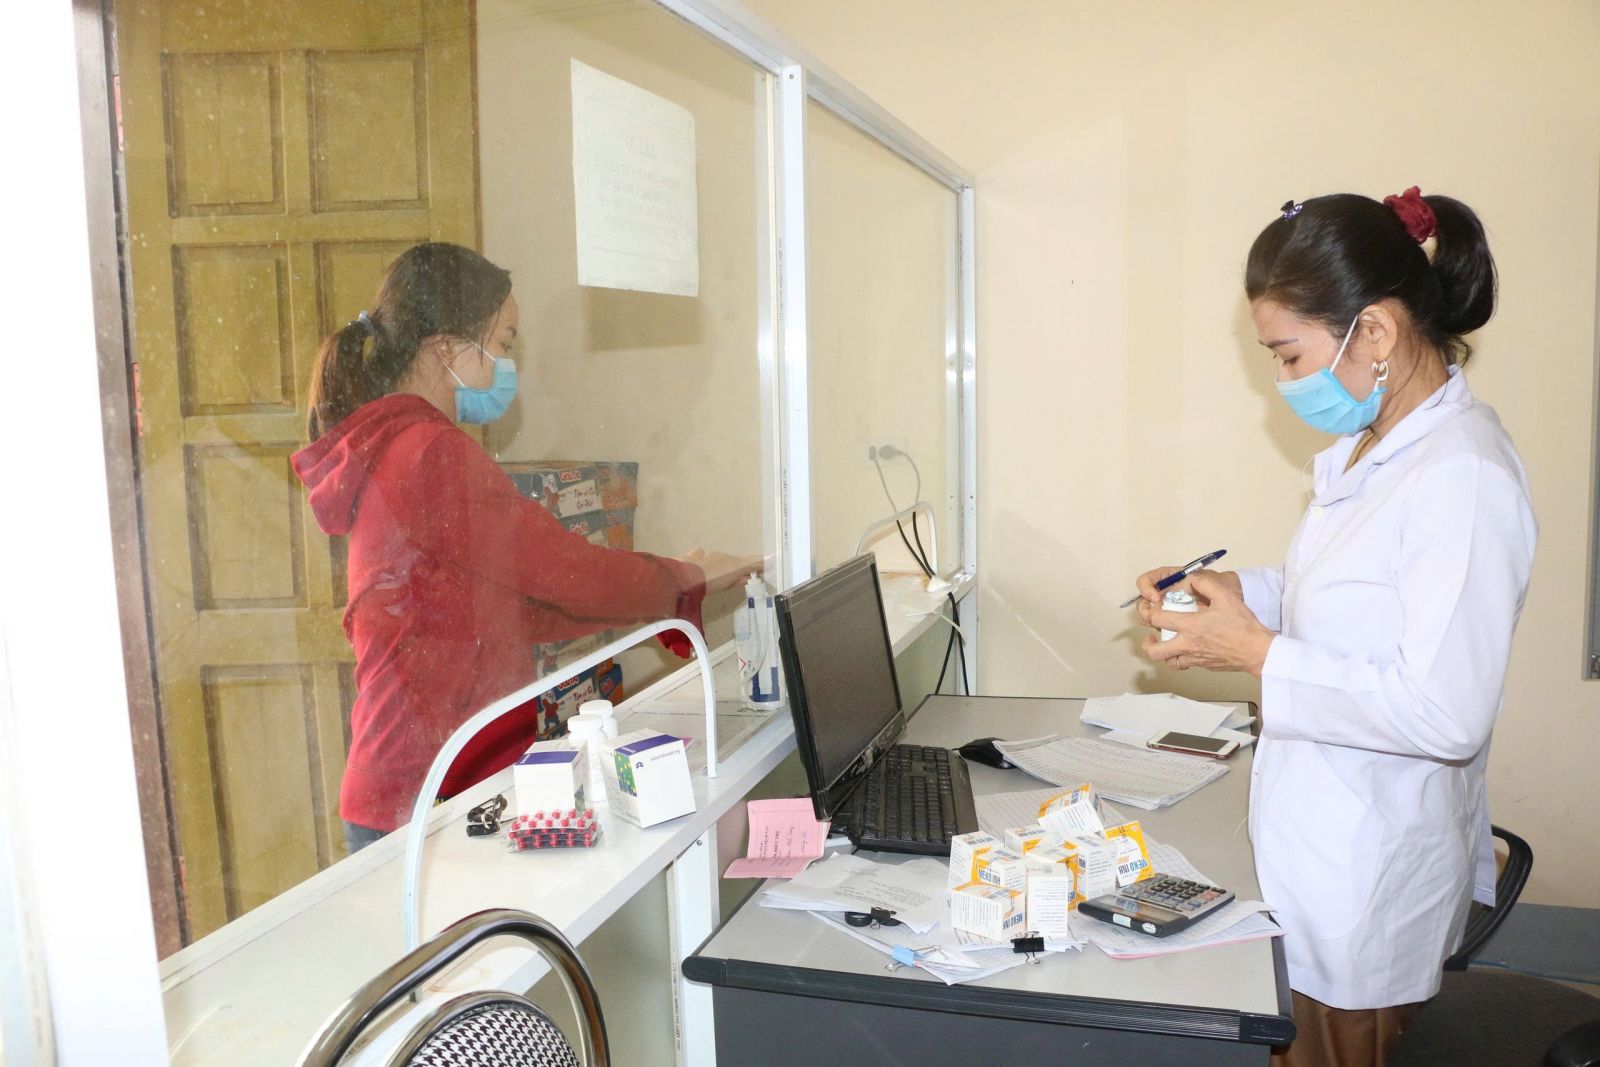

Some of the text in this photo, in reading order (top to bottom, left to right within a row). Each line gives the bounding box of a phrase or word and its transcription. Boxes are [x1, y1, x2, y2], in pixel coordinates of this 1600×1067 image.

[1118, 858, 1148, 875] MEKO INH
[978, 868, 992, 882] MEKO
[1010, 912, 1023, 926] MEKO
